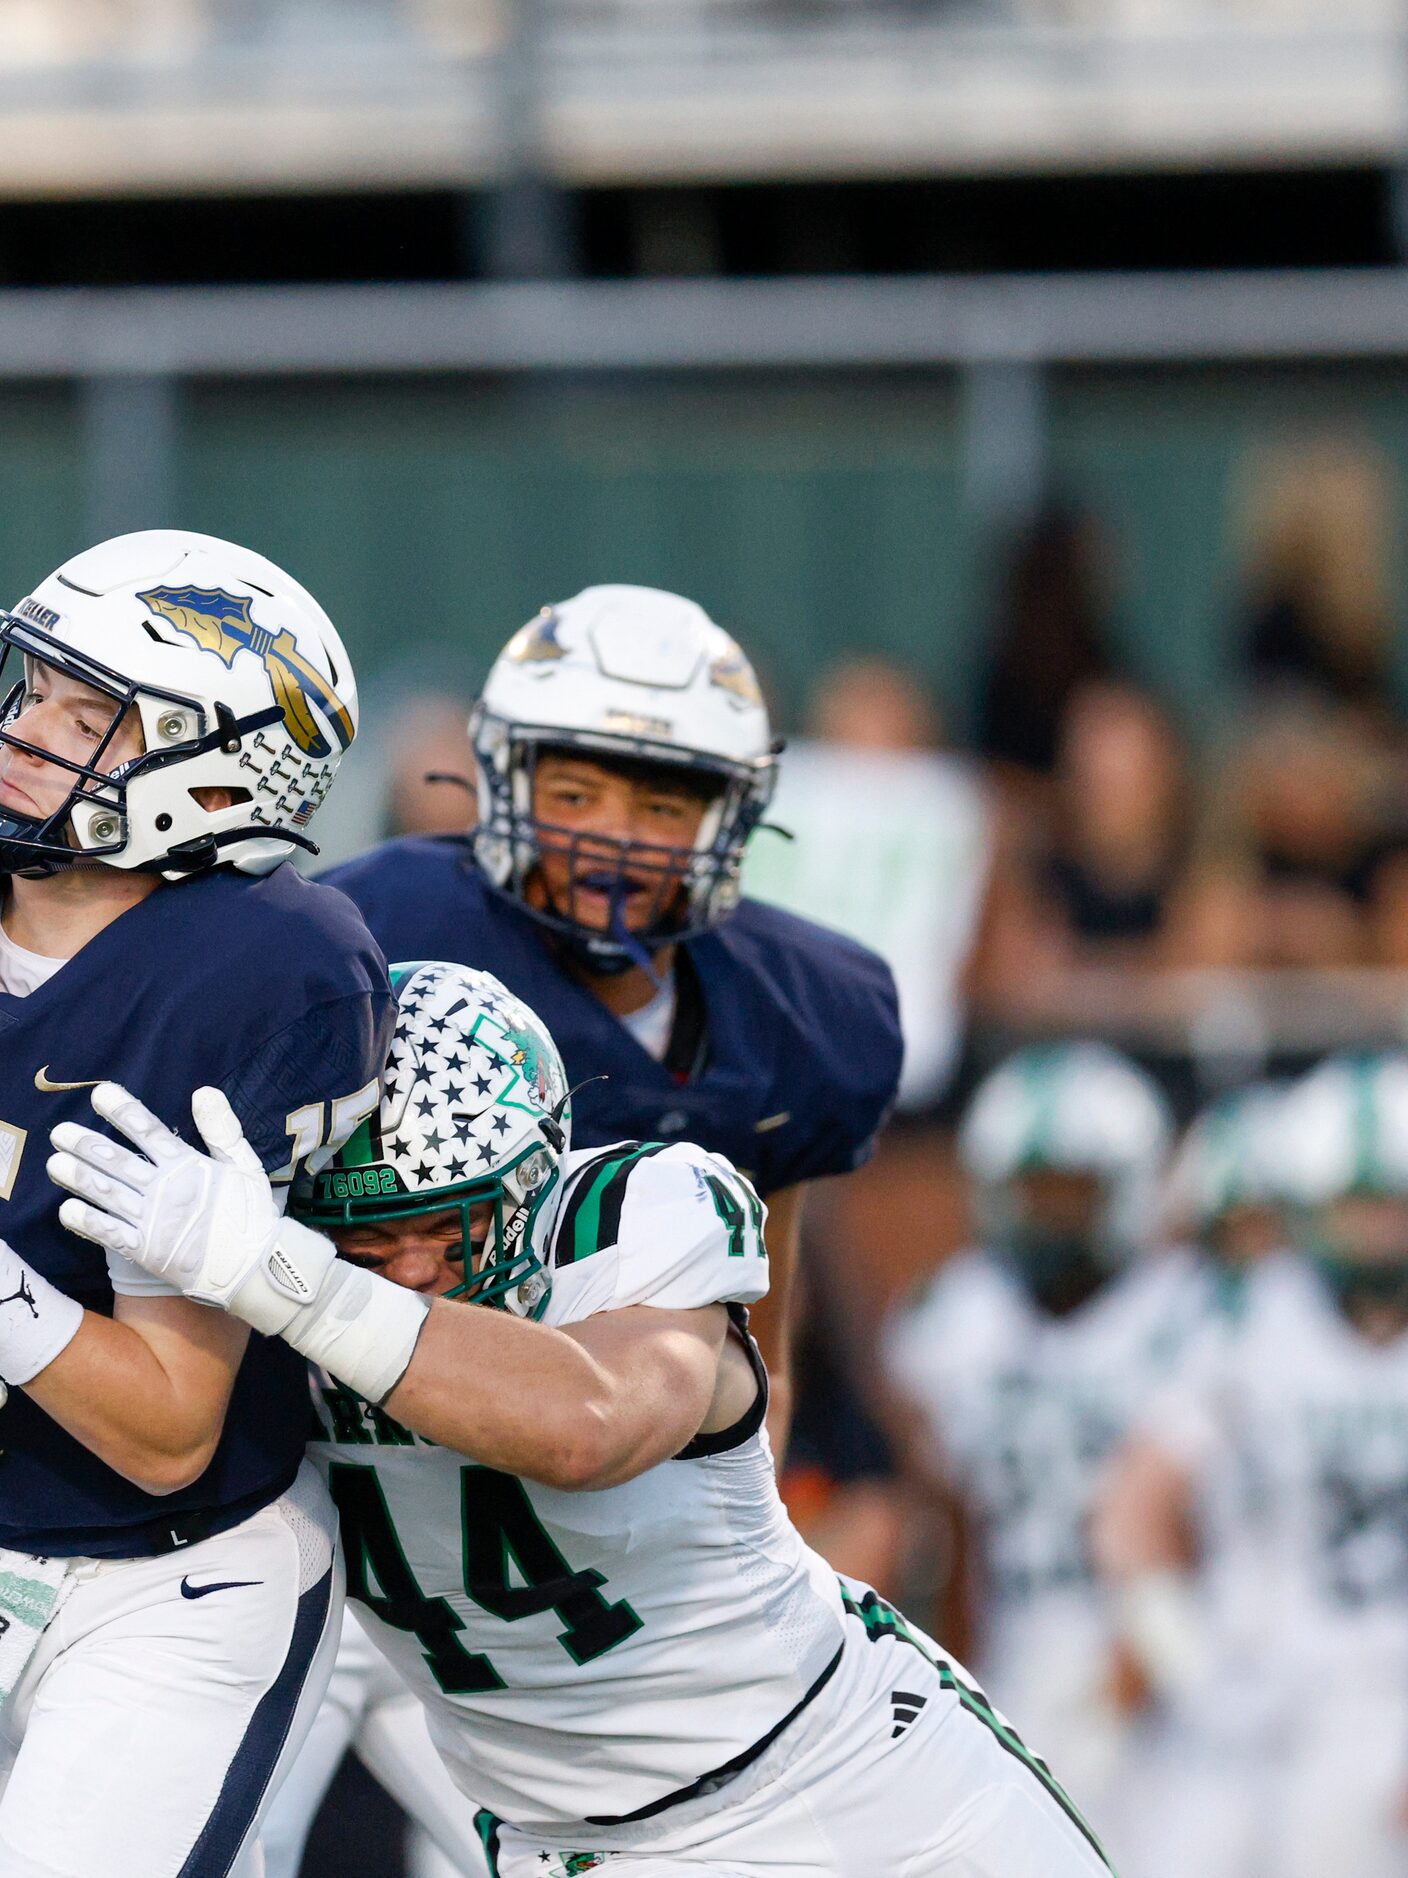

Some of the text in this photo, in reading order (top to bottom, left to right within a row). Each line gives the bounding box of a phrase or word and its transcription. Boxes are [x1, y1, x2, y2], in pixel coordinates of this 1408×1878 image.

[319, 1168, 398, 1199] 76092
[275, 1250, 309, 1294] CUTTERS
[170, 1530, 188, 1546] L
[328, 1462, 645, 1694] 44
